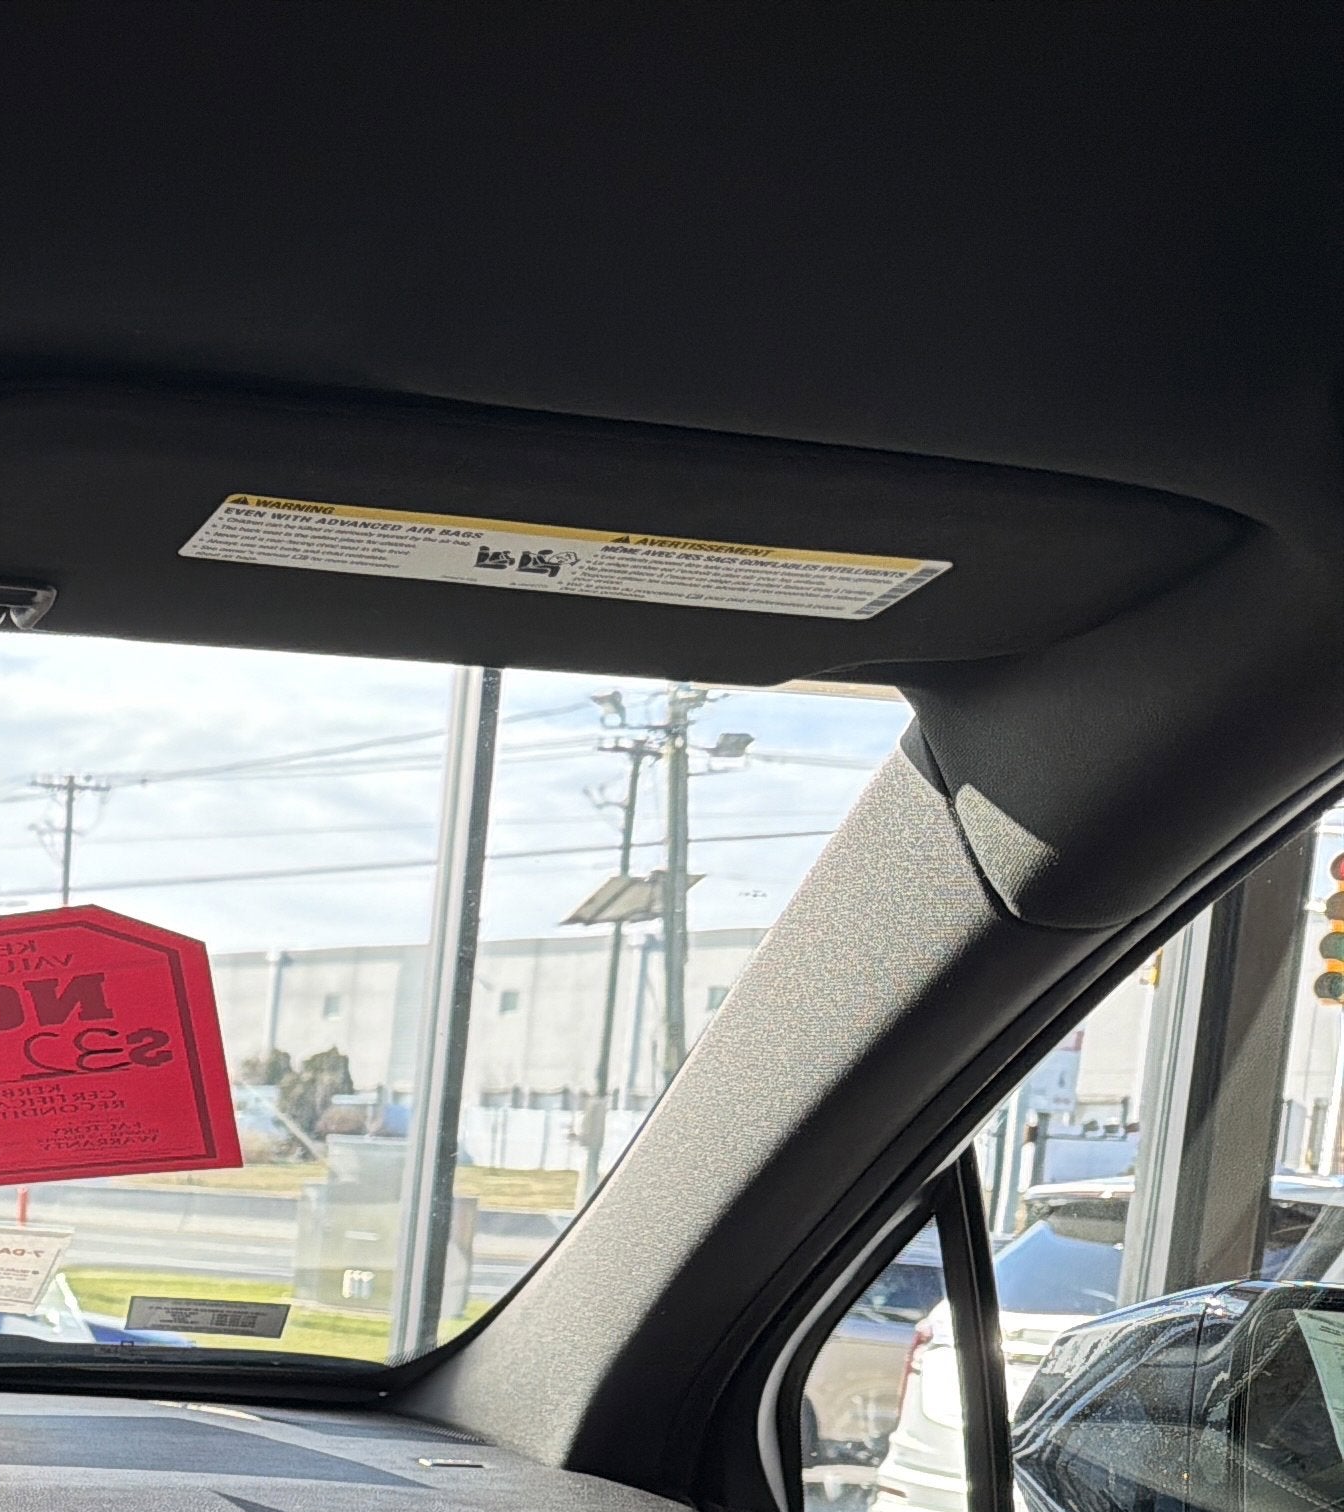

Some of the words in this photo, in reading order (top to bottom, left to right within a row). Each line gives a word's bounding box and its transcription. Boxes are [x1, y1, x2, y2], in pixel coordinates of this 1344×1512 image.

[255, 499, 336, 515] WARNING
[224, 507, 267, 518] EVEN
[270, 512, 313, 523] WITH
[315, 517, 403, 531] ADVANCED
[406, 526, 436, 535] AIR
[439, 529, 484, 539] BAGS
[635, 537, 772, 557] AVERTISSEMENT
[601, 546, 642, 556] MÊME
[641, 549, 676, 559] AVEC
[676, 552, 703, 561] DES
[703, 555, 739, 565] SACS
[739, 557, 821, 571] GONFLABLES
[820, 565, 908, 578] INTELLIGENTS
